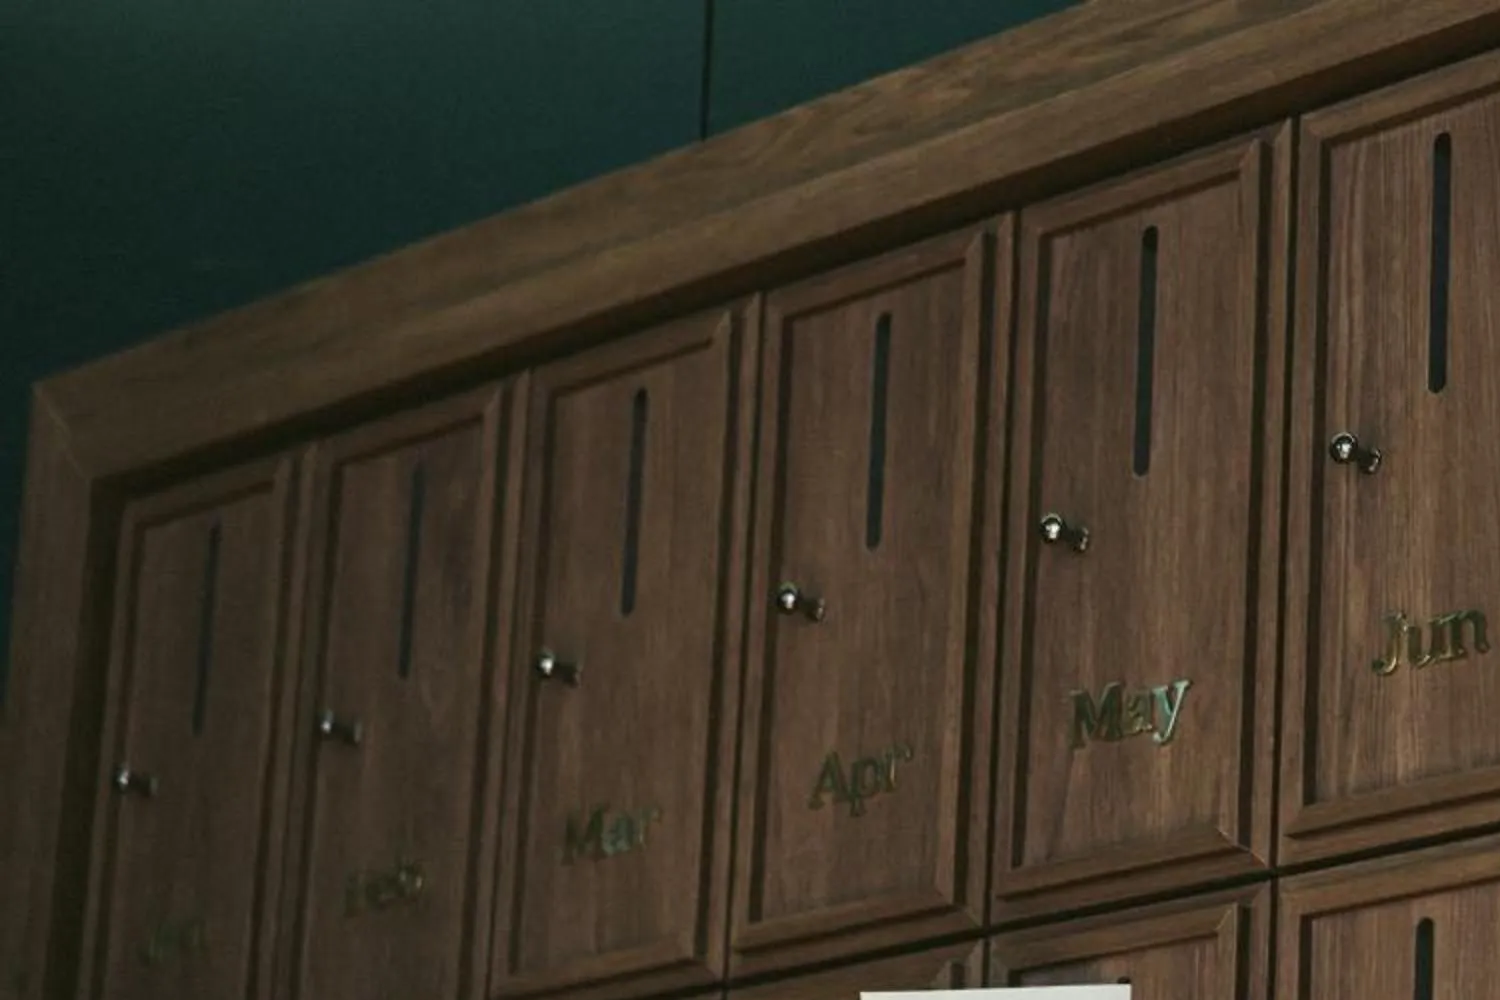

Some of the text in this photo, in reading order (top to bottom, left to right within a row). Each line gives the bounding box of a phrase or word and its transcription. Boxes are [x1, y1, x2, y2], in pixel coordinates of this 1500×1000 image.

[1372, 607, 1491, 676] Jun
[1070, 678, 1191, 750] May
[808, 742, 914, 818] Apr
[562, 804, 663, 867] Mar
